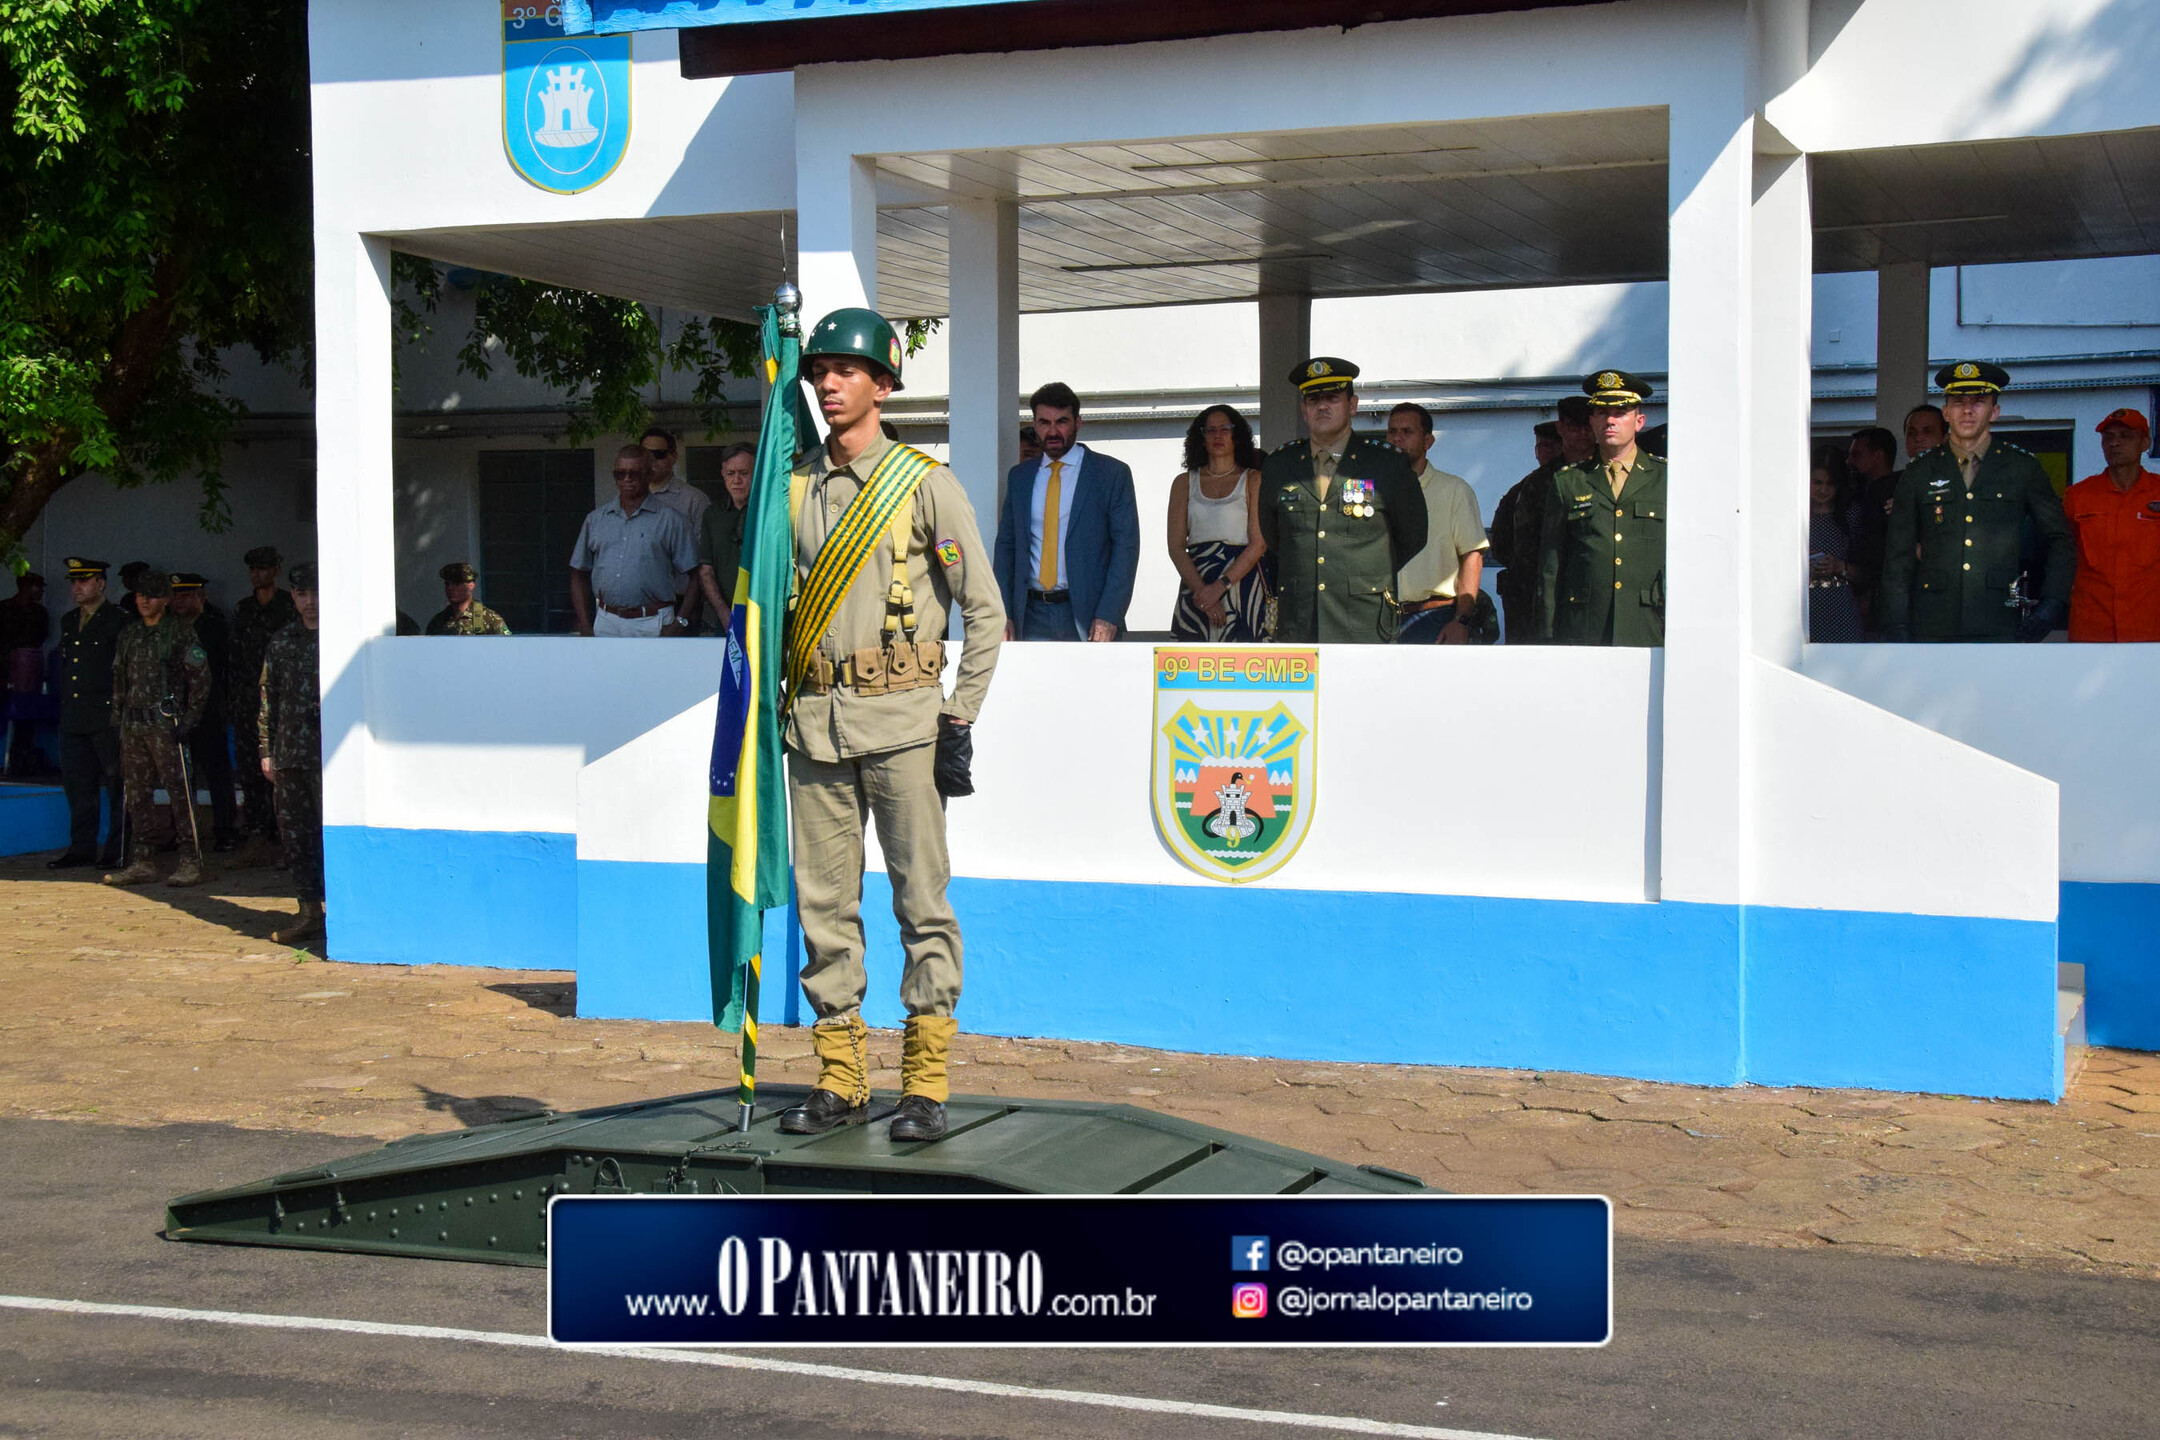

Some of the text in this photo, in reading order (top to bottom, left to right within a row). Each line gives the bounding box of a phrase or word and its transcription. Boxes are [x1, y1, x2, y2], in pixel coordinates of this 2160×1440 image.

[544, 4, 563, 27] G
[1163, 656, 1309, 683] 9º BE CMB
[1226, 826, 1240, 848] 9
